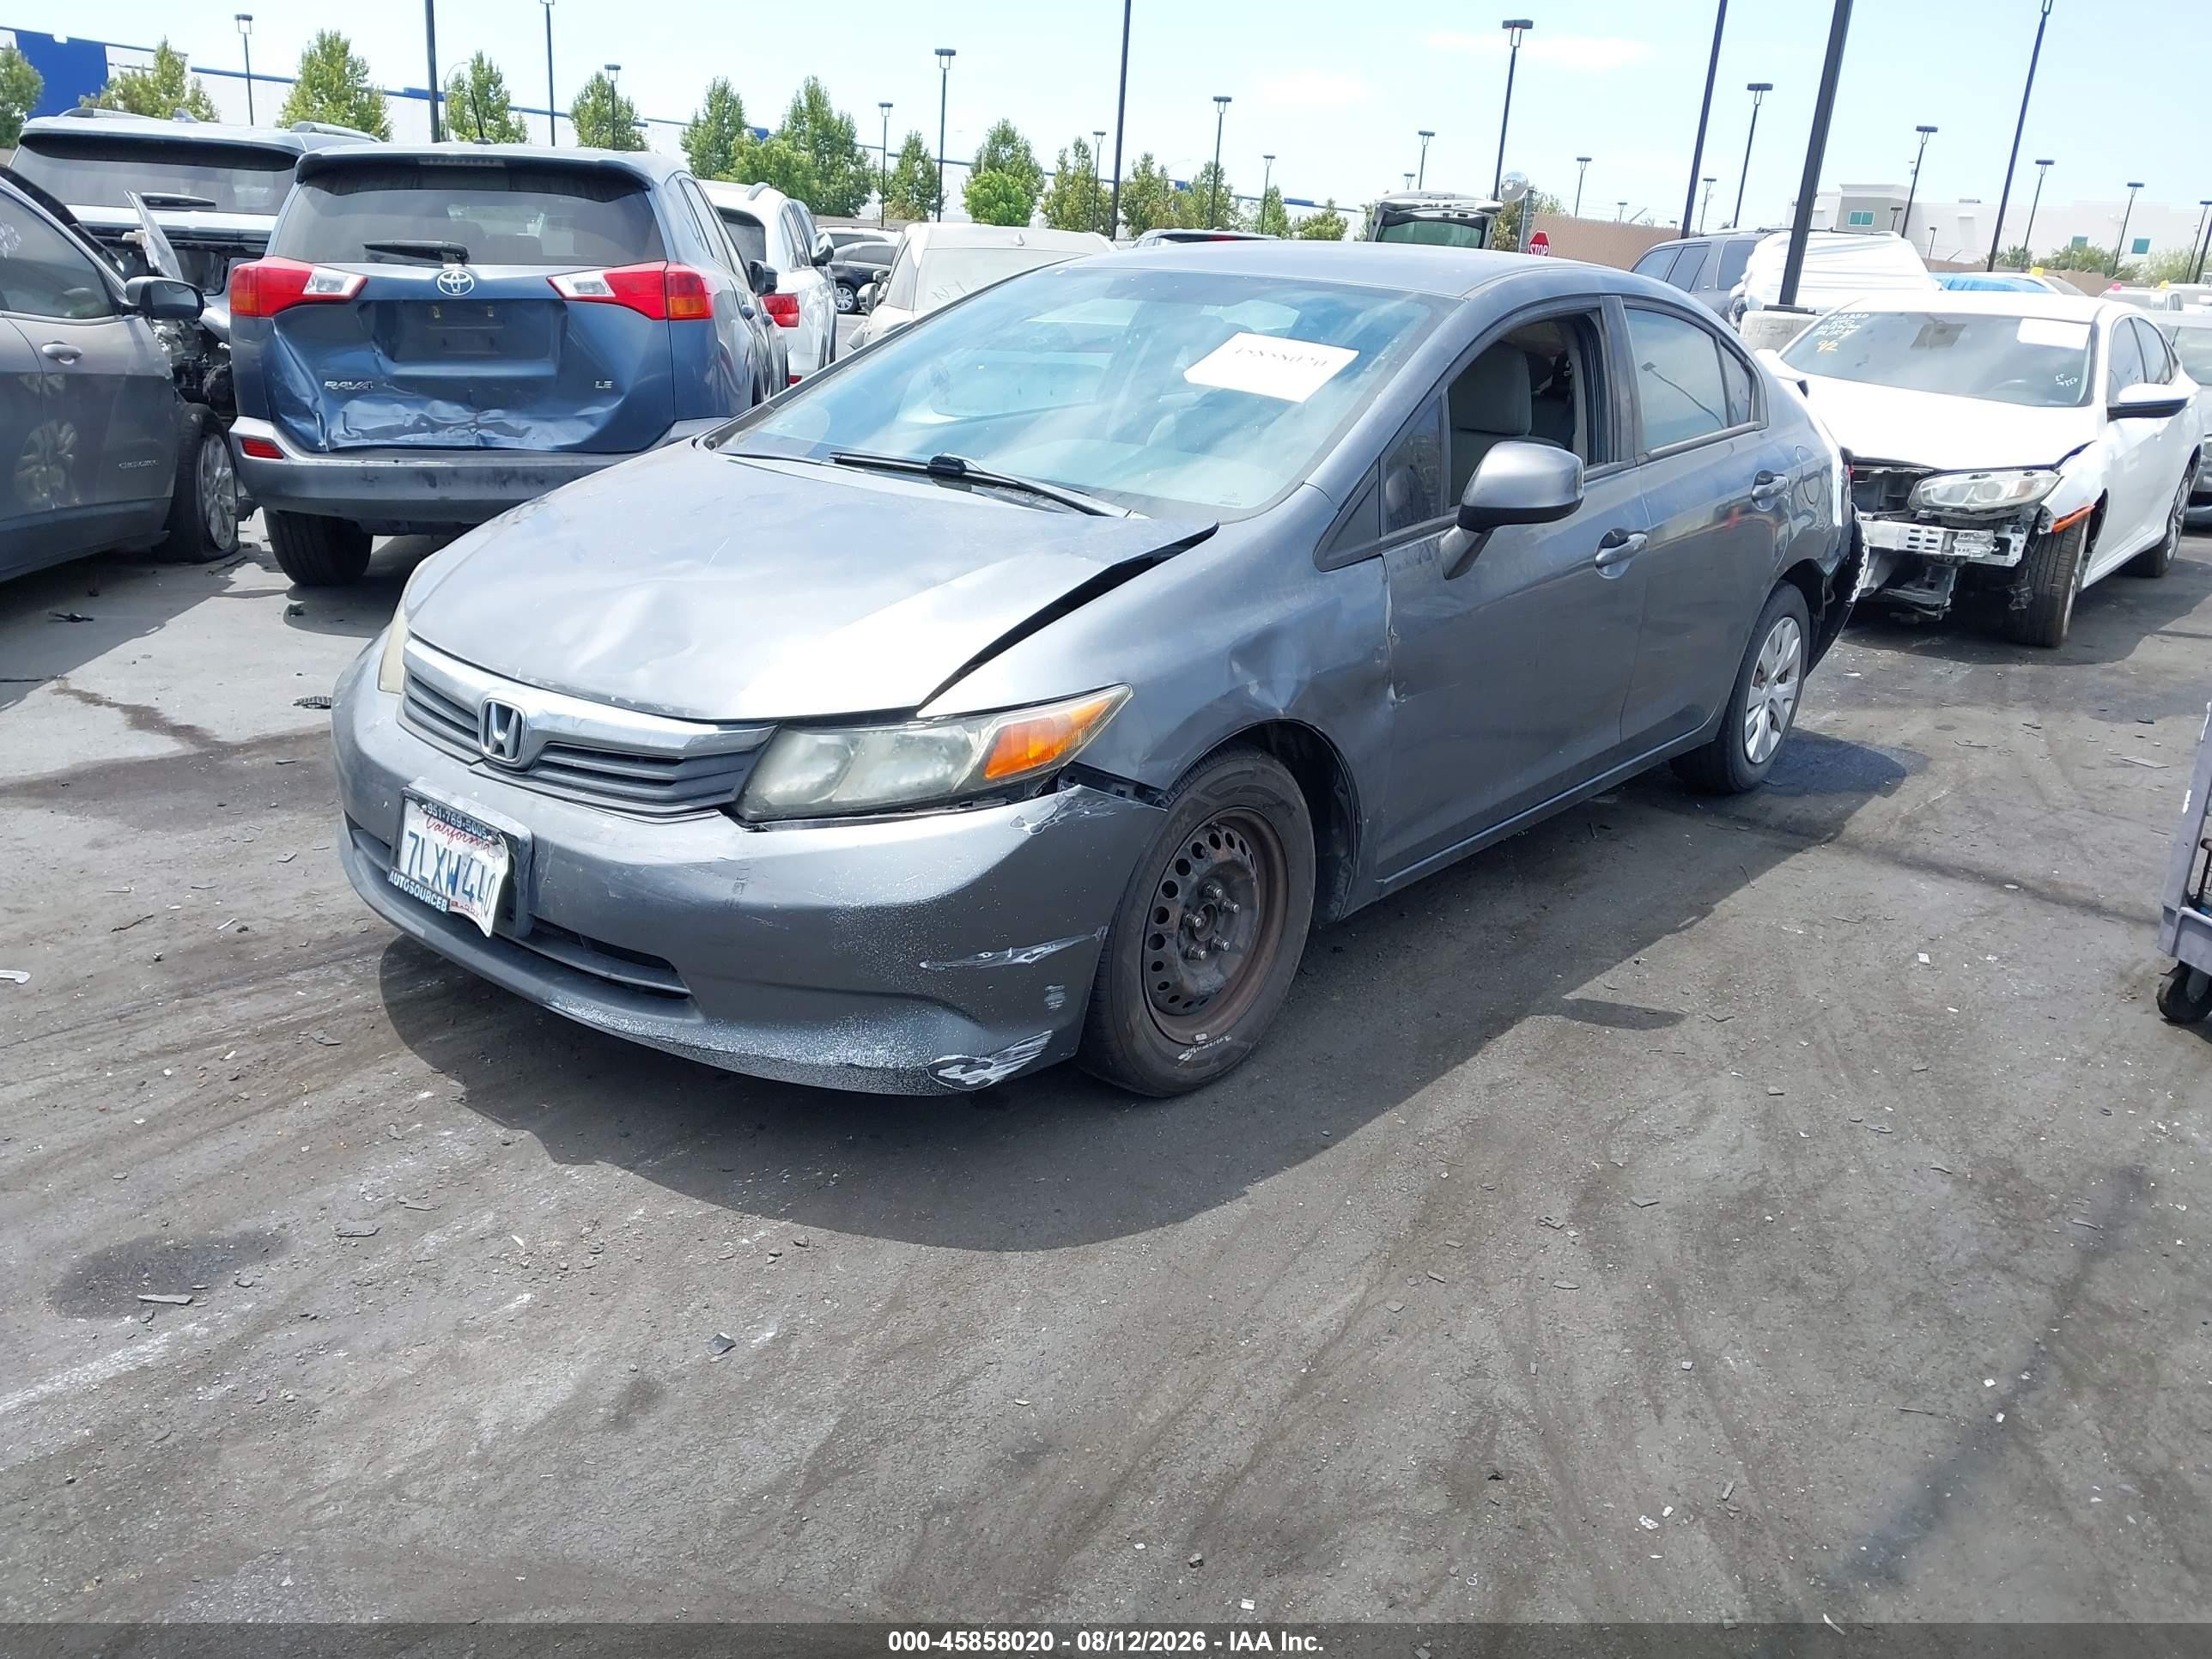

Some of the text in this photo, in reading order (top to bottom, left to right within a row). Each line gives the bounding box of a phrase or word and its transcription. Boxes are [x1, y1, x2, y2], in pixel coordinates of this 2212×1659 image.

[1530, 244, 1548, 256] STOP
[323, 380, 374, 391] RAV4
[595, 380, 613, 389] LE
